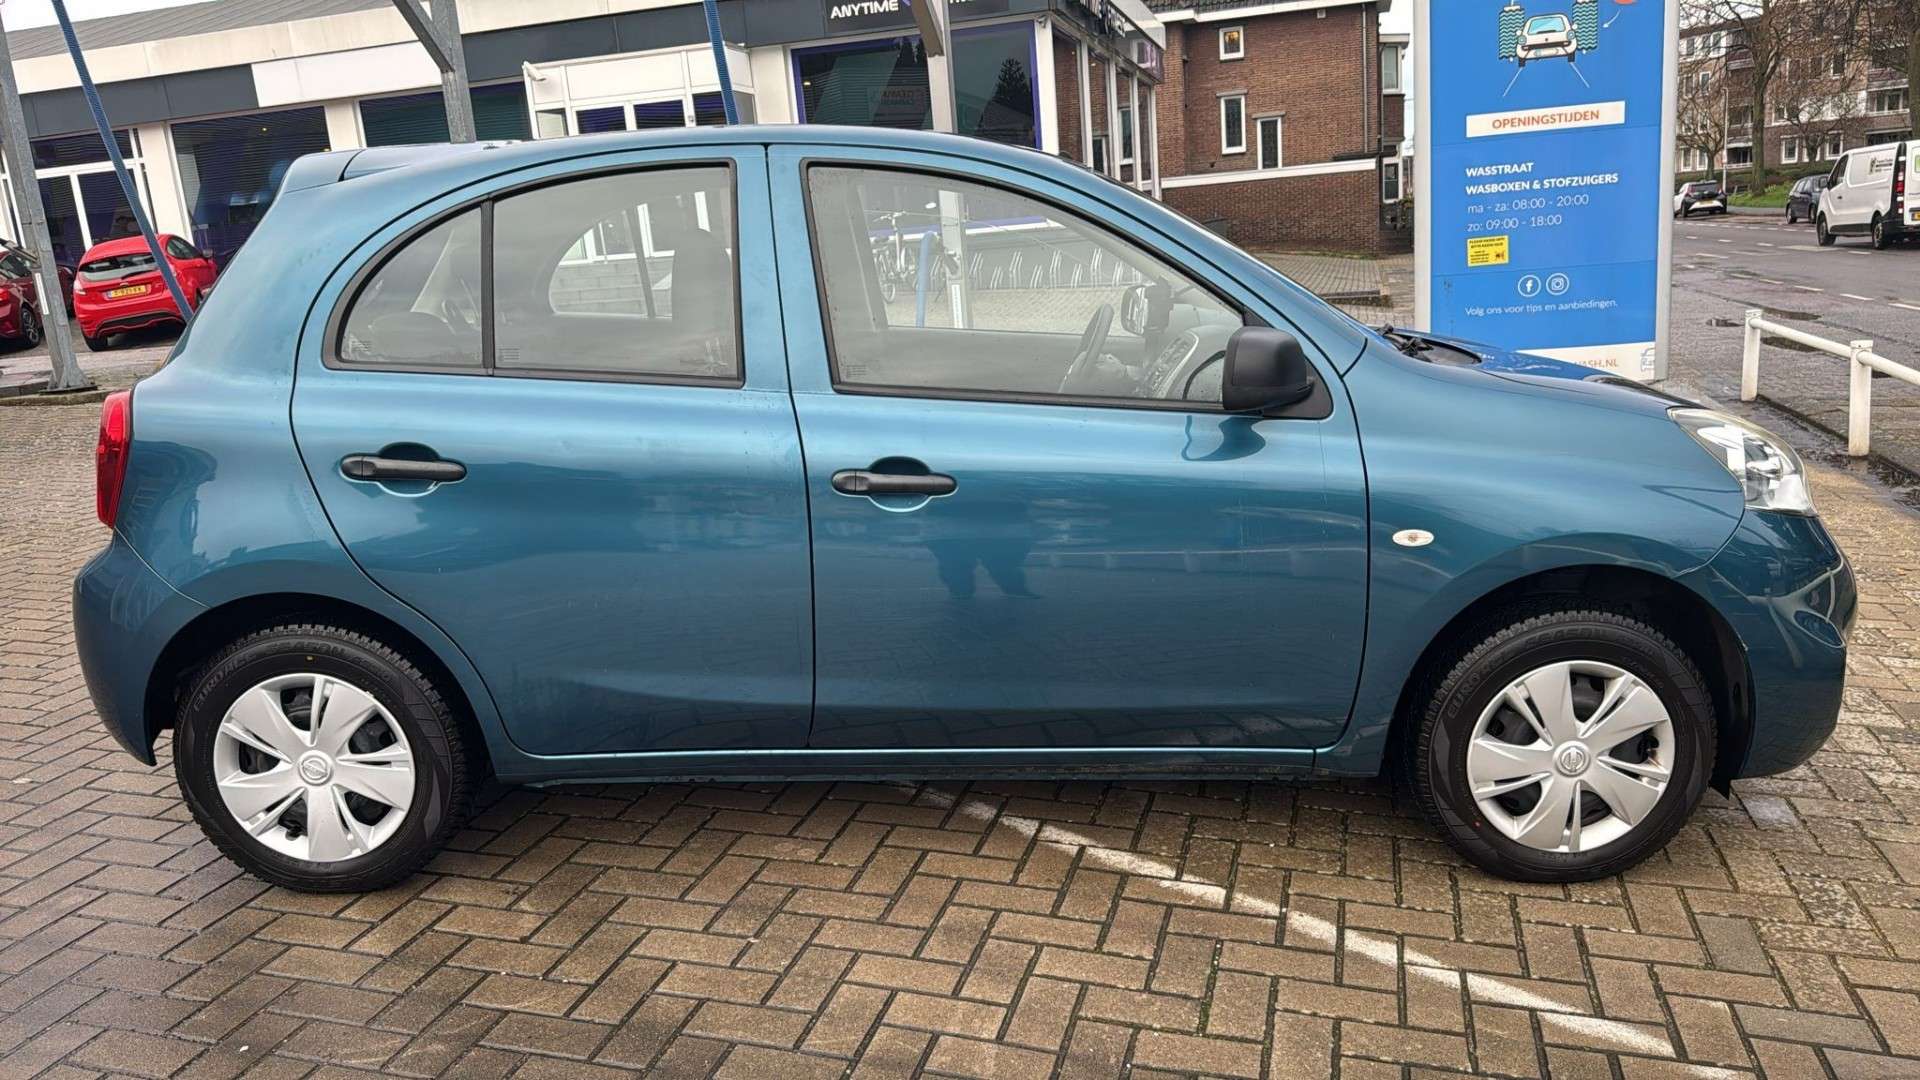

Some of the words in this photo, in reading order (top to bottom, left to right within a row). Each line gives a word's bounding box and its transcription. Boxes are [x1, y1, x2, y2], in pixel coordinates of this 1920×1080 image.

[830, 0, 899, 19] ANYTIME
[1491, 109, 1600, 129] OPENINGSTIJDEN
[1465, 162, 1534, 177] WASSTRAAT
[1465, 181, 1530, 195] WASBOXEN
[1532, 180, 1541, 190] &
[1543, 173, 1619, 189] STOFZUIGERS
[1467, 205, 1484, 213] ma
[1495, 202, 1510, 212] za:
[1512, 197, 1546, 210] 08:00
[1556, 193, 1589, 207] 20:00
[1467, 221, 1482, 232] zo:
[1485, 217, 1519, 231] 09:00
[1530, 214, 1562, 227] 18:00
[1465, 307, 1485, 317] Volg
[1504, 306, 1525, 314] voor
[1526, 303, 1543, 313] tips
[1558, 299, 1618, 310] aanbiedingen.
